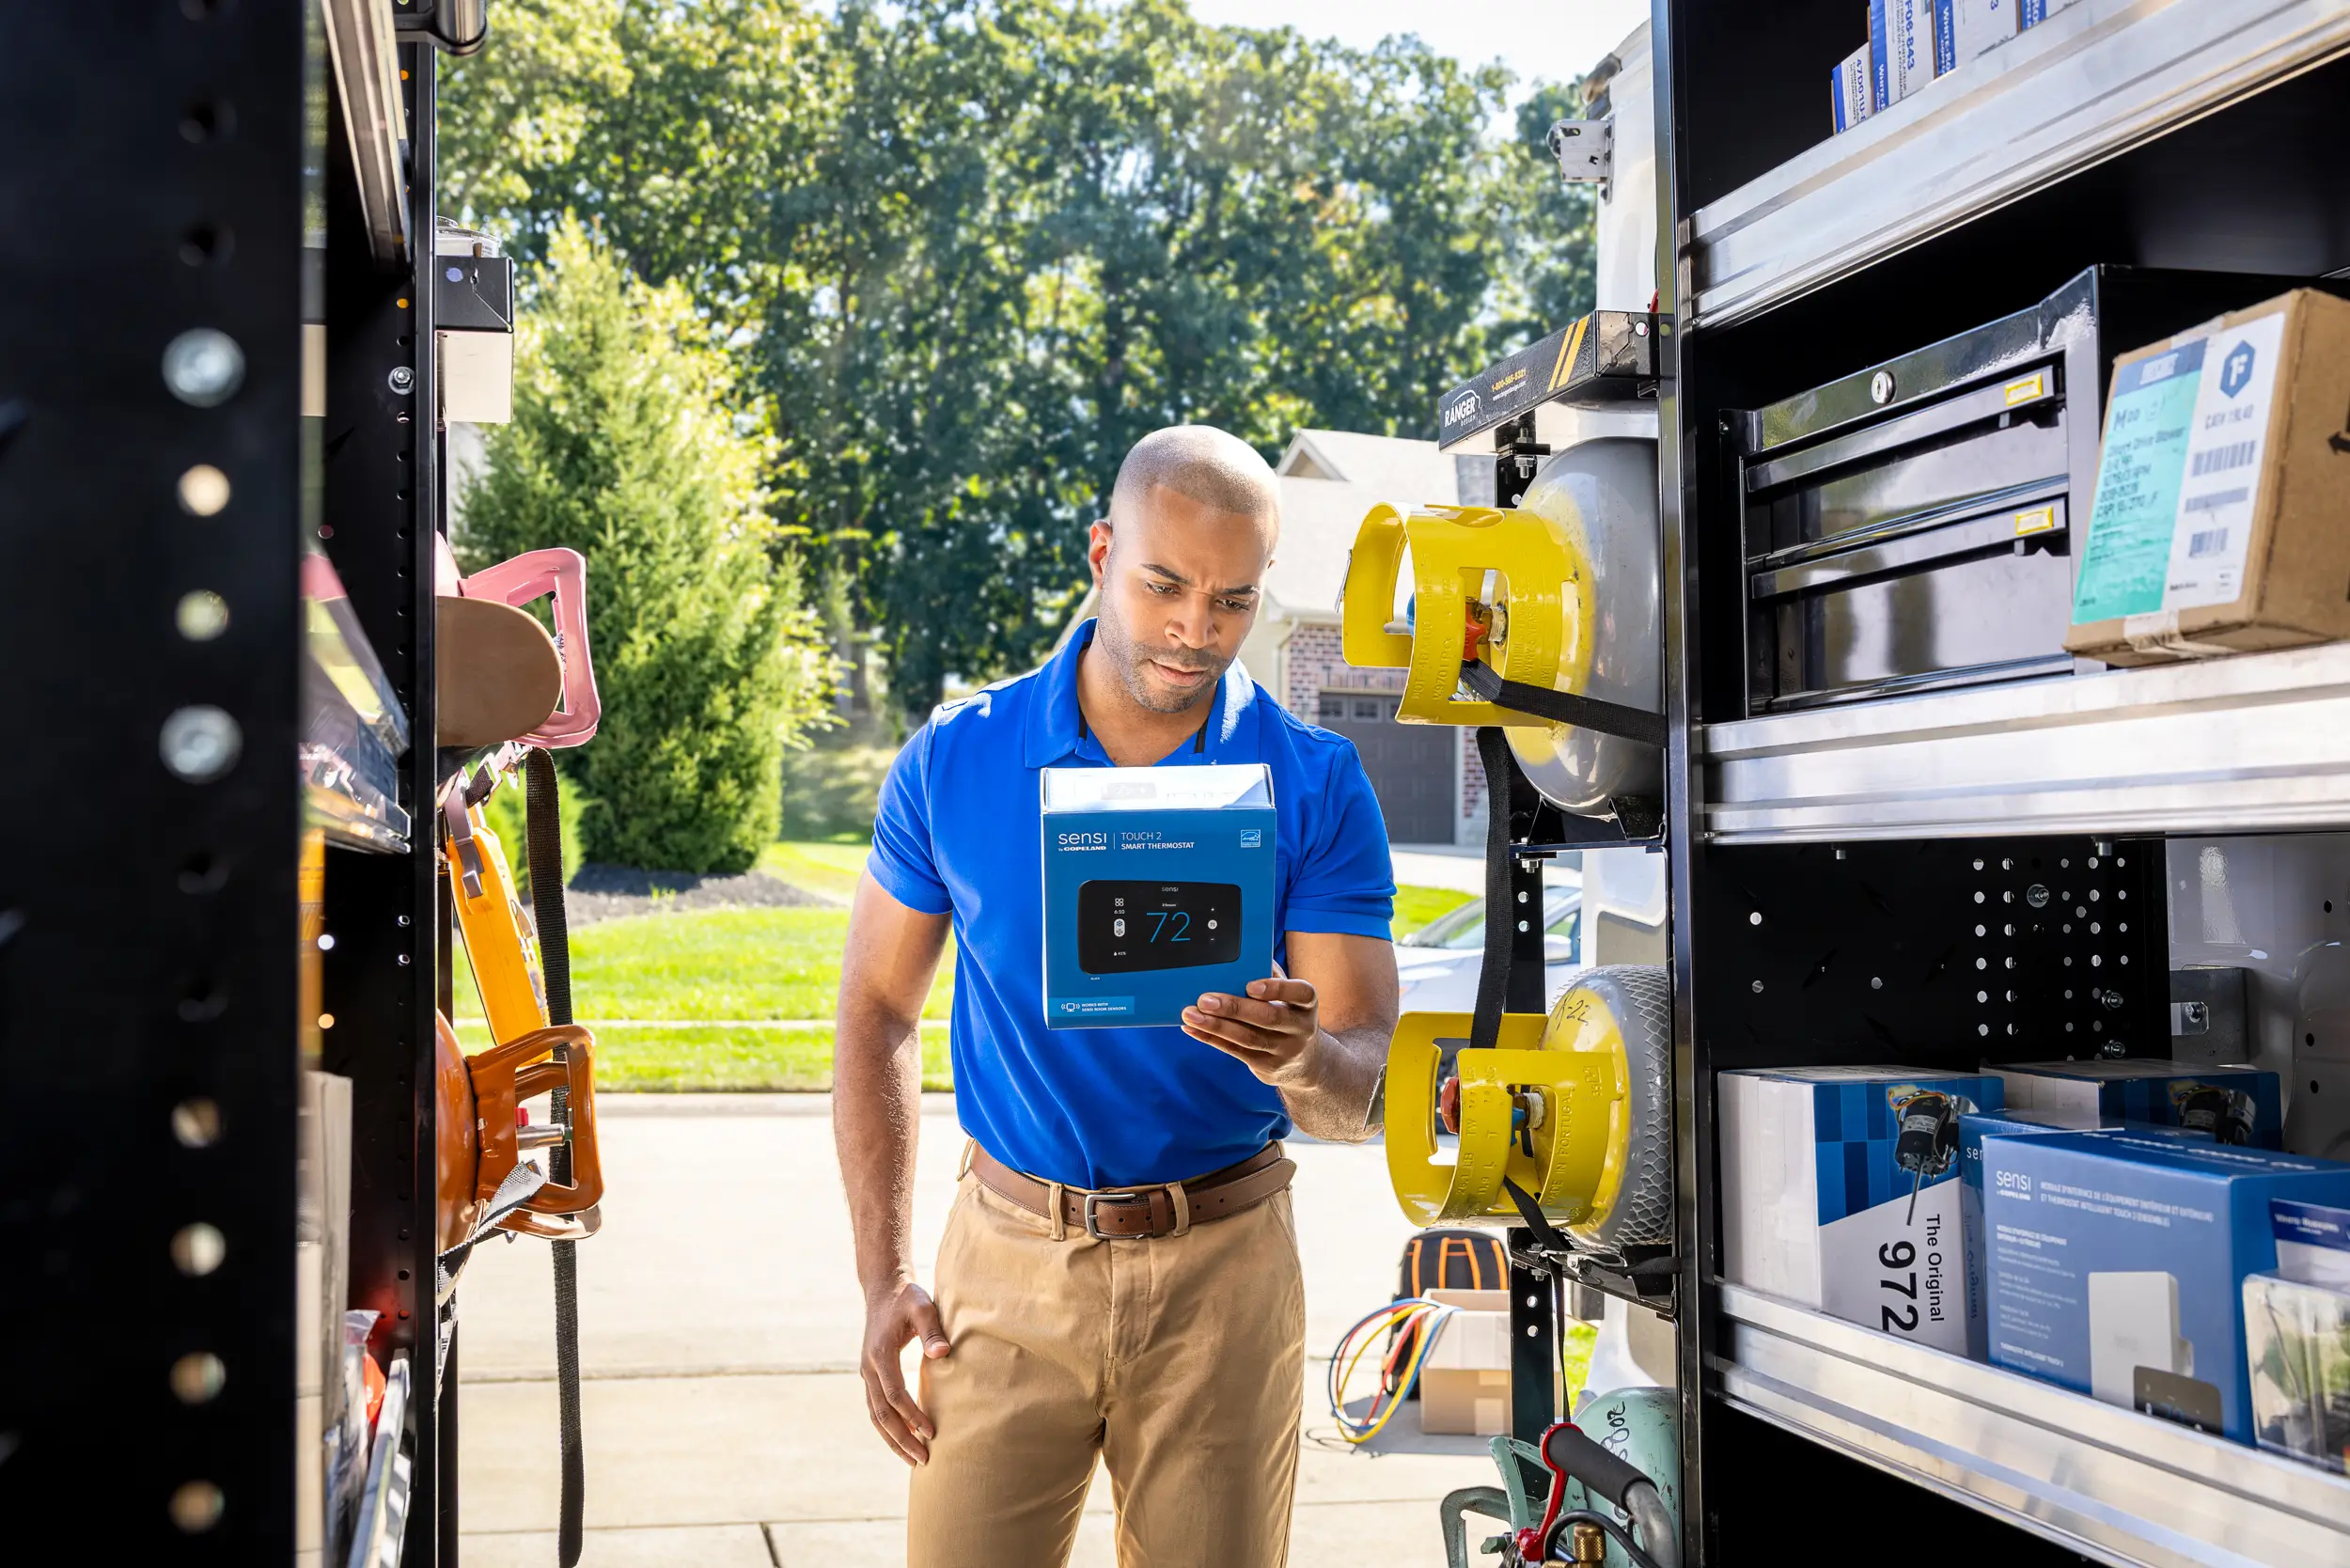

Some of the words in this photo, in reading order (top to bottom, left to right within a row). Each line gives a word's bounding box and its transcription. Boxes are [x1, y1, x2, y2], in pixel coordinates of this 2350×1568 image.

[1445, 396, 1476, 428] RANGER
[1058, 832, 1106, 845] sensi
[1120, 832, 1153, 840] TOUCH
[1156, 832, 1162, 840] 2
[1147, 912, 1191, 943] 72
[1559, 1090, 1574, 1156] PORTUGAL
[1556, 1162, 1567, 1174] IN
[1996, 1169, 2031, 1191] sensi
[1546, 1180, 1563, 1206] MADE
[1926, 1214, 1941, 1247] The
[1878, 1240, 1919, 1333] 972
[1928, 1252, 1945, 1323] Original
